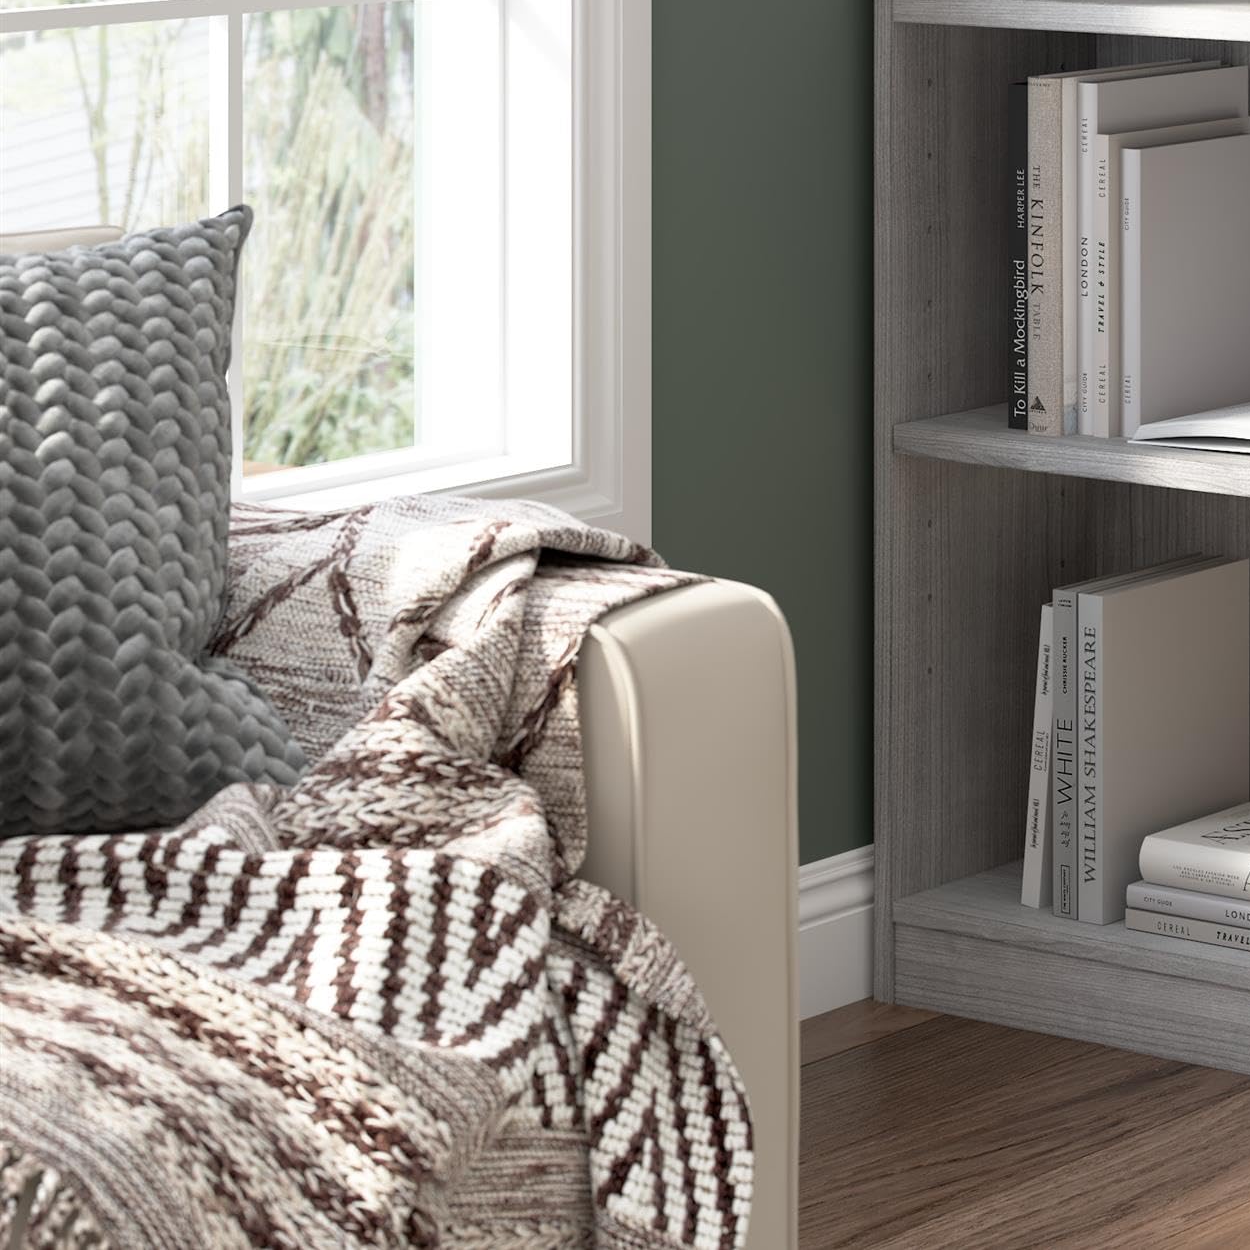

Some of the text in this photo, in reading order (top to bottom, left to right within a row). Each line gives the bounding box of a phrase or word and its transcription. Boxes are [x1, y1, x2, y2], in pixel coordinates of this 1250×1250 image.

[1013, 168, 1029, 418] To Kill a Mockingbird HARPER LEE
[1030, 165, 1044, 342] THE KINFOLK TABLE
[1056, 718, 1073, 805] WHITE
[1084, 626, 1096, 883] WILLIAM SHAKESPEARE
[1157, 921, 1191, 937] CEREAL
[1216, 931, 1250, 946] TRAVEL
